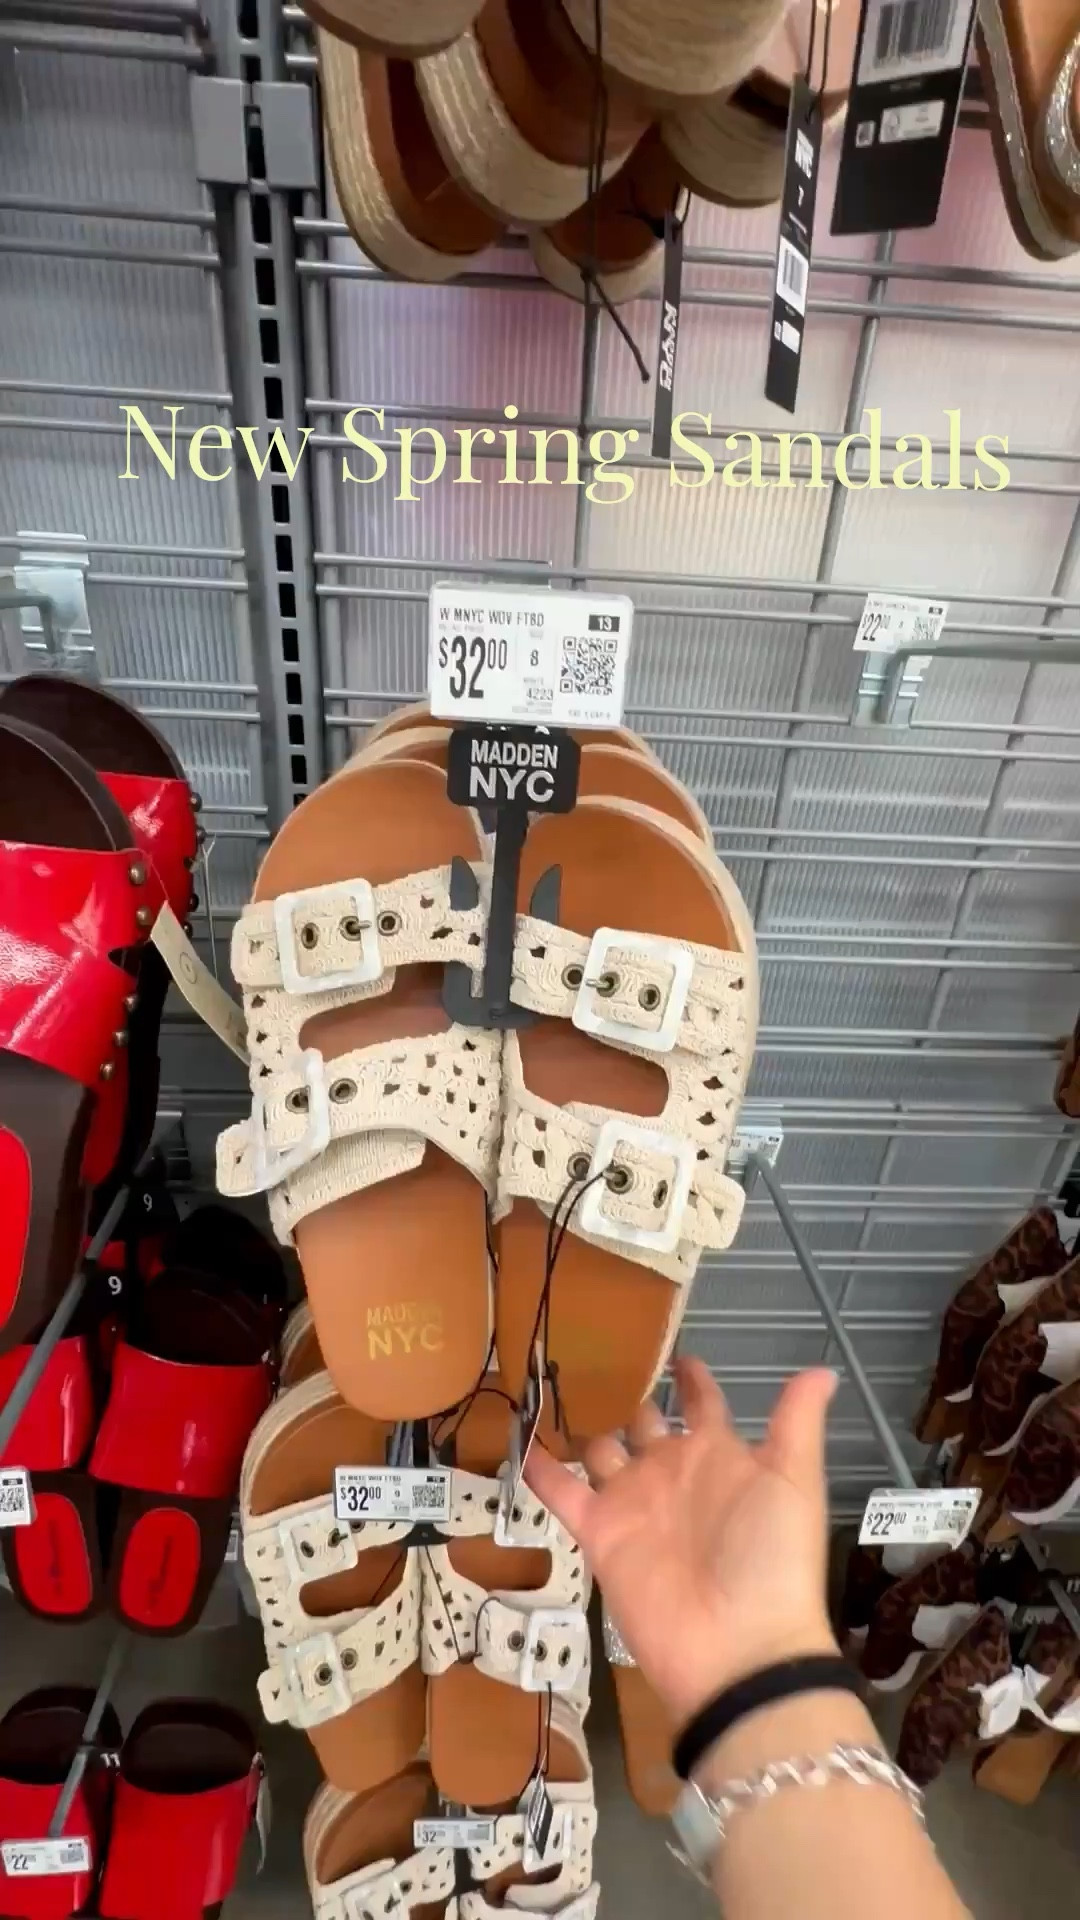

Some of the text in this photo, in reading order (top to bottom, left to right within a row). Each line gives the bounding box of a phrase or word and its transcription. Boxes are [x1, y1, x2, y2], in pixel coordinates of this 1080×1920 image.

[530, 649, 539, 666] 8
[470, 739, 559, 769] MADDEN
[469, 765, 555, 803] NYC
[143, 1193, 153, 1212] 9
[107, 1275, 122, 1296] 9
[367, 1323, 445, 1361] NYC
